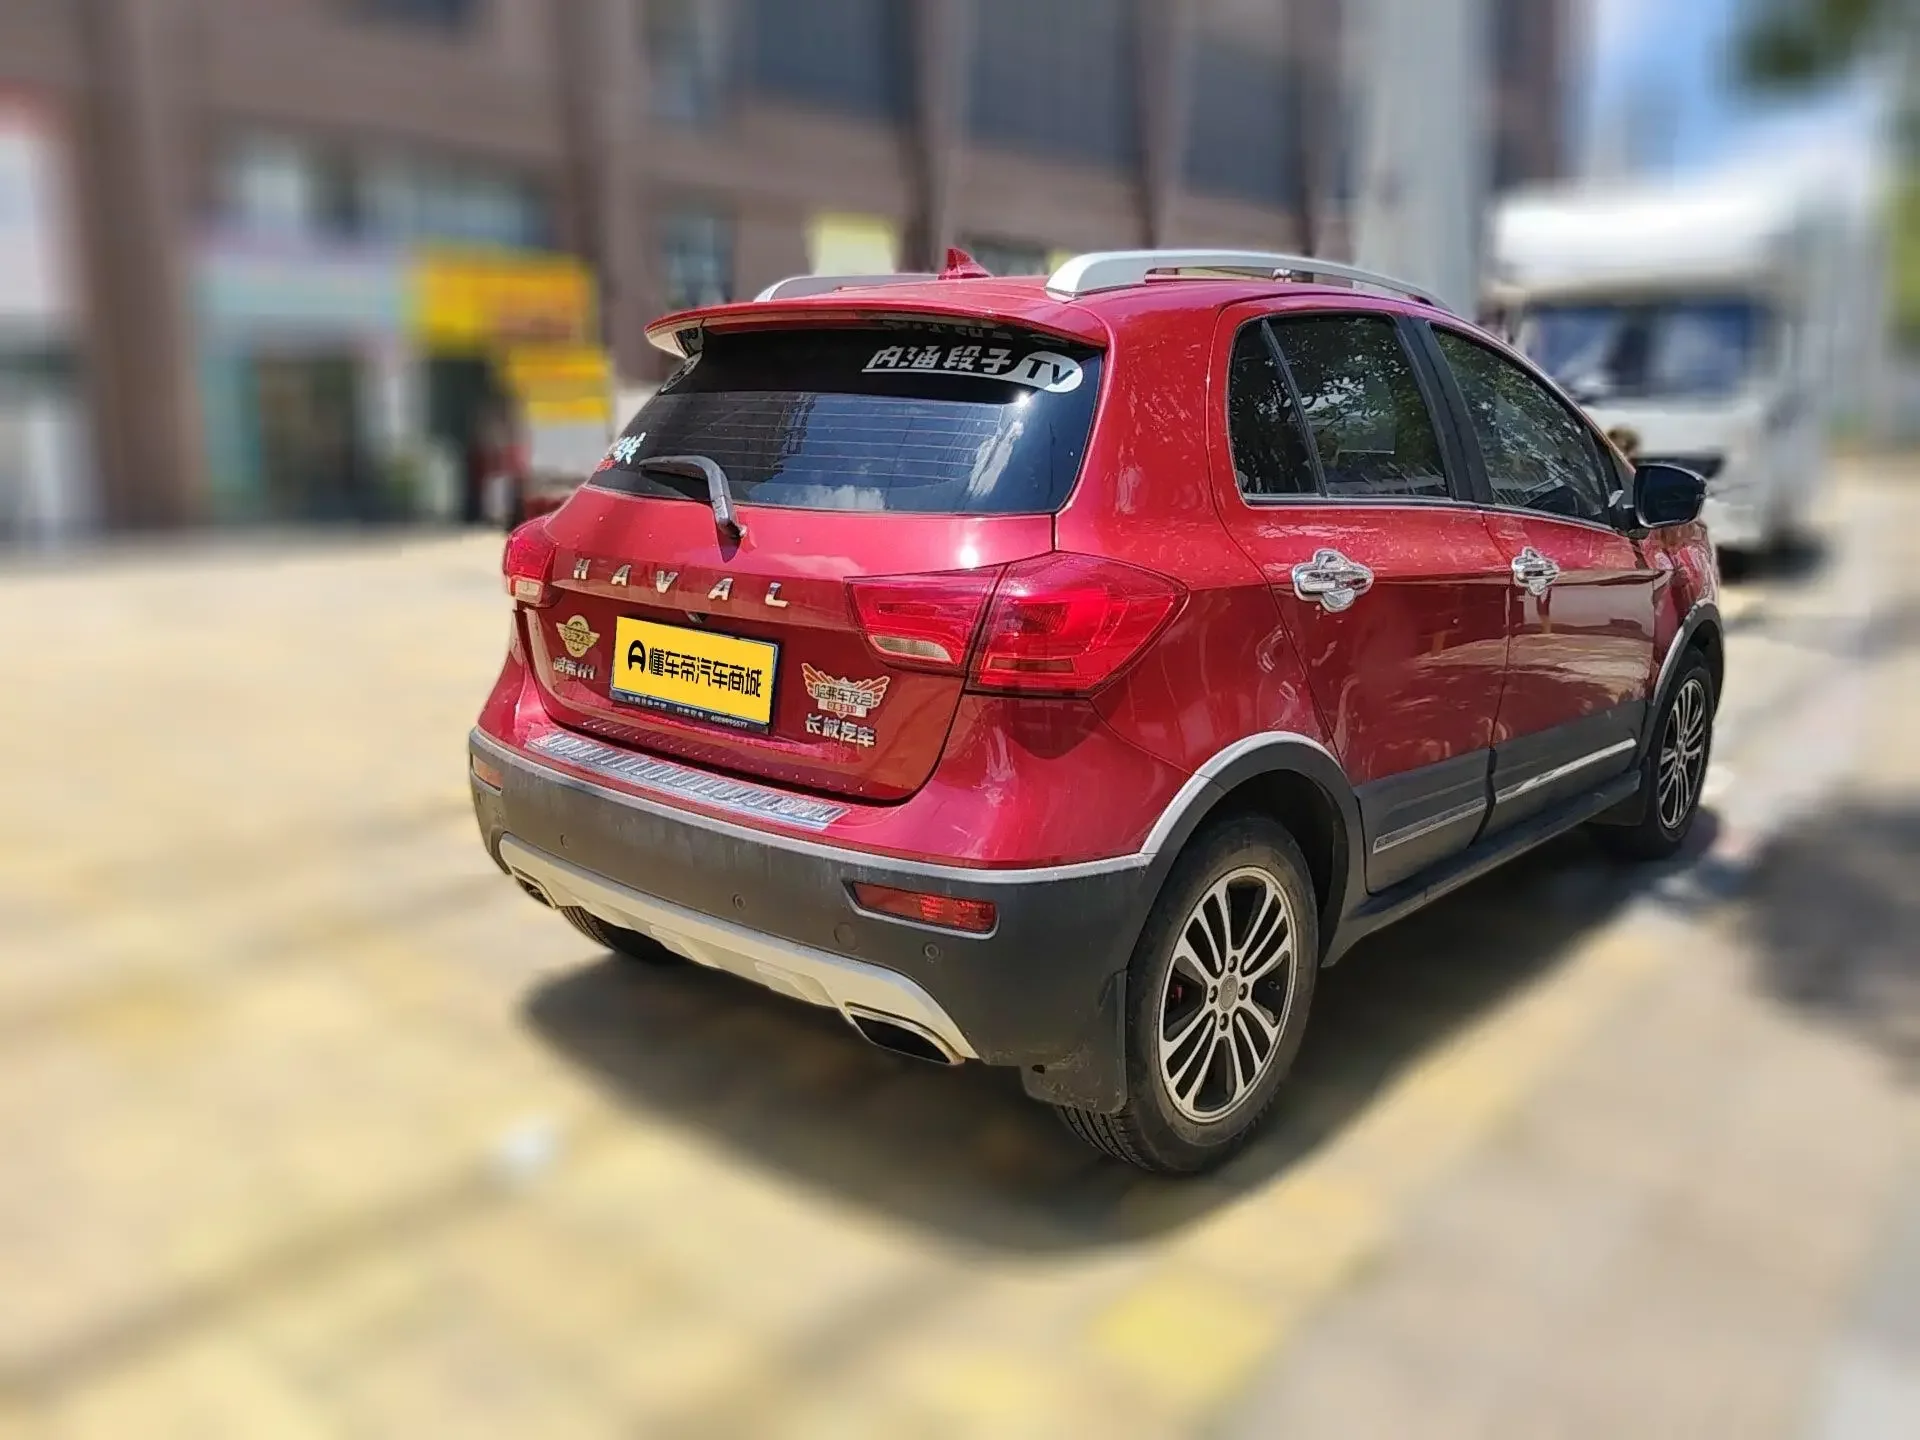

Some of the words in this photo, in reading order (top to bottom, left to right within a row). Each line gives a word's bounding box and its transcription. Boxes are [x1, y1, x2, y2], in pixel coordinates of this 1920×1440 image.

[1026, 357, 1074, 385] TV
[571, 556, 789, 608] HAVAL
[805, 712, 875, 748] 长城汽车
